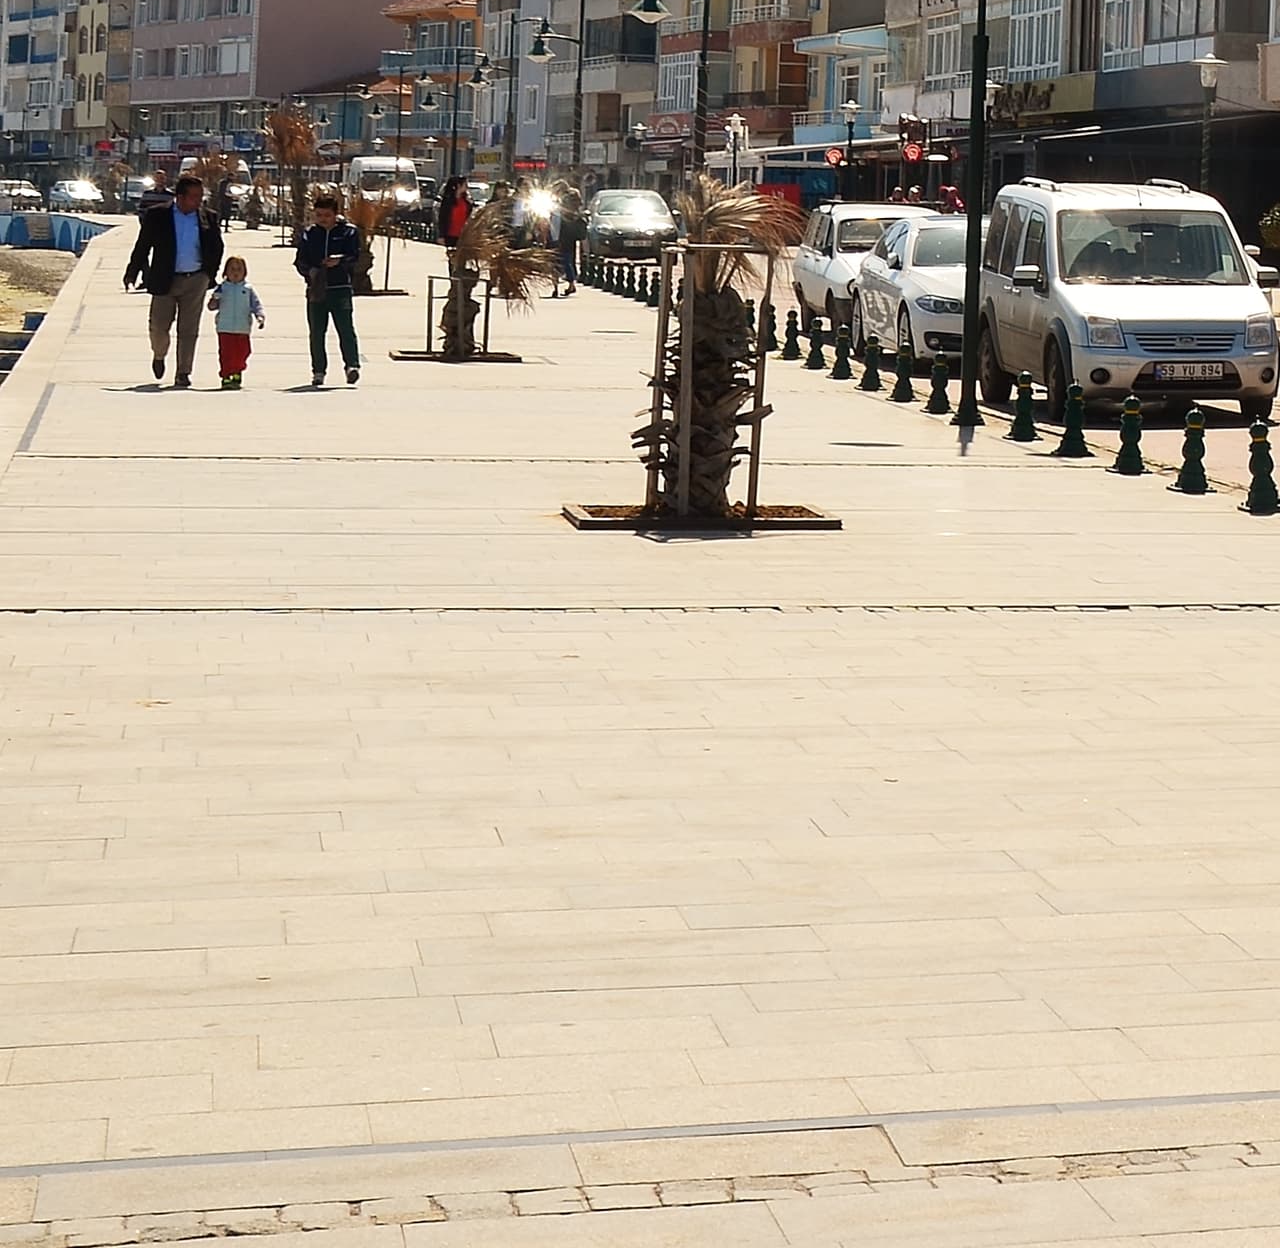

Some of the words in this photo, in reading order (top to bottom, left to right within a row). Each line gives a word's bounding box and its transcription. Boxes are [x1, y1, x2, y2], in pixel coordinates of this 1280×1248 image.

[1161, 364, 1175, 376] 59
[1182, 365, 1196, 376] YU
[1201, 365, 1221, 376] 894
